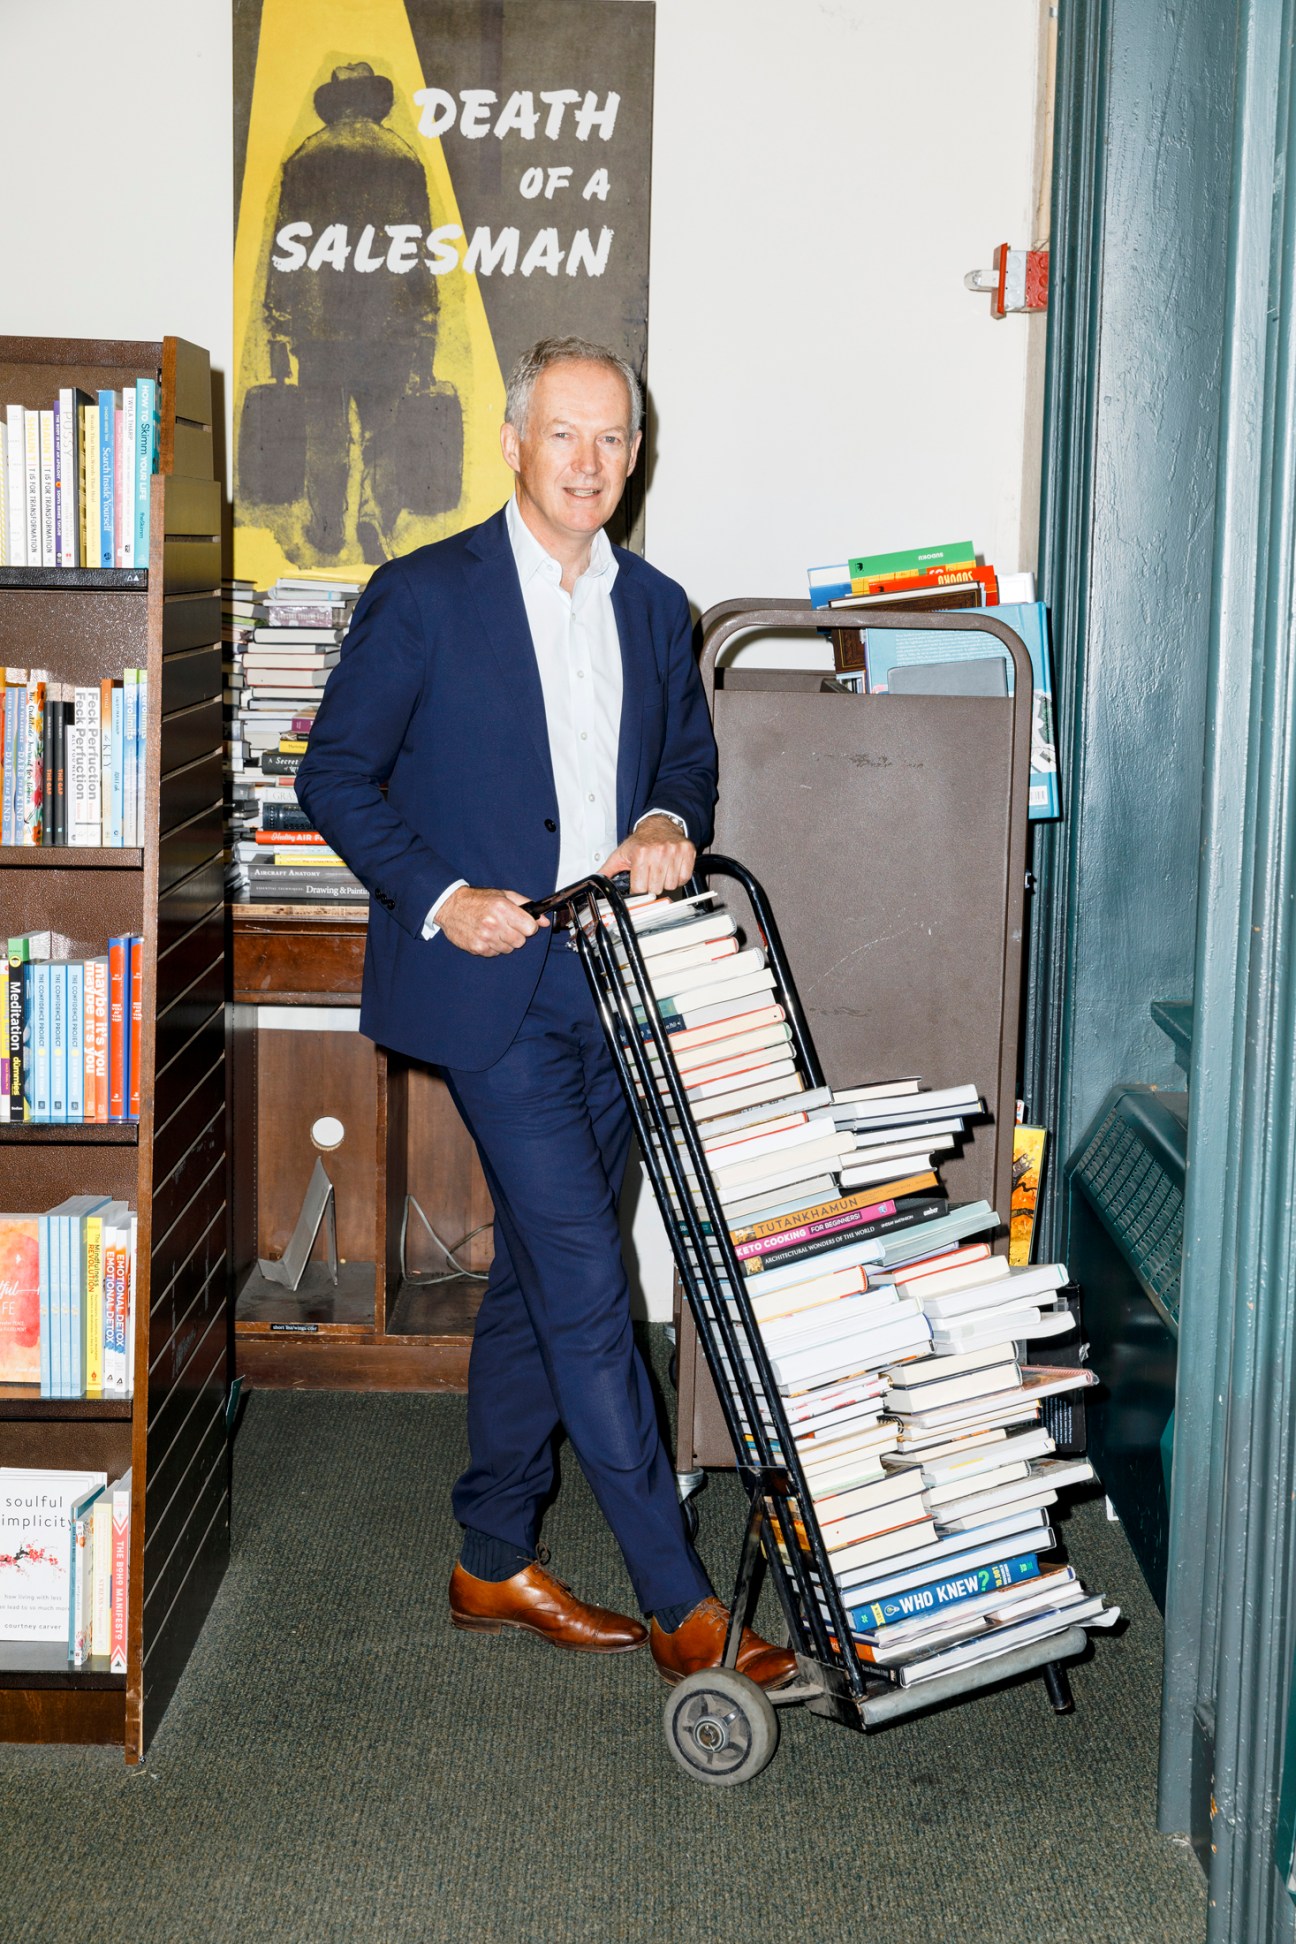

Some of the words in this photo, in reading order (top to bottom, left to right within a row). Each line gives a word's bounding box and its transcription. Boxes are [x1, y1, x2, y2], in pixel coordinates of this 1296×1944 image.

[414, 88, 621, 141] DEATH
[520, 166, 572, 199] OF
[583, 168, 610, 201] A
[273, 222, 614, 277] SALESMAN
[142, 410, 148, 421] TO
[27, 417, 35, 452] SHAUN
[42, 417, 51, 453] SHAUN
[62, 412, 73, 457] PUSSY
[140, 423, 150, 455] Skimm
[28, 454, 35, 462] T
[103, 448, 111, 473] Search
[103, 475, 111, 498] Inside
[29, 496, 37, 552] TRANSFORMATION
[103, 500, 111, 531] Yourself
[918, 552, 943, 560] SUDOKU
[938, 571, 973, 585] SUDOKU
[76, 692, 85, 724] Feck
[88, 692, 98, 724] Feck
[76, 729, 86, 800] Perfuction
[89, 729, 98, 800] Perfuction
[103, 745, 111, 768] KEY
[306, 886, 338, 896] Drawing
[340, 886, 346, 894] &
[347, 887, 370, 896] Paintin
[95, 963, 106, 1016] maybe
[10, 982, 21, 1050] Meditation
[96, 1022, 107, 1046] it's
[12, 1057, 21, 1095] dummies
[85, 1048, 94, 1073] you
[95, 1050, 104, 1076] you
[759, 1198, 858, 1234] TUTANKHAMUN
[736, 1241, 762, 1257] KETO
[764, 1230, 806, 1248] COOKING
[810, 1222, 824, 1233] FOR
[825, 1214, 860, 1229] BEGINNERS!
[765, 1246, 808, 1264] ARCHITECTURAL
[808, 1237, 835, 1251] WONDERS
[844, 1232, 854, 1240] THE
[854, 1226, 875, 1237] WORLD
[106, 1252, 114, 1308] EMOTIONAL
[116, 1255, 124, 1312] EMOTIONAL
[106, 1311, 114, 1342] DETOX
[6, 1496, 62, 1507] soulful
[116, 1541, 124, 1559] THE
[116, 1562, 124, 1585] BOHO
[899, 1591, 934, 1614] WHO
[936, 1570, 990, 1603] KNEW?
[115, 1589, 124, 1640] MANIFESTO
